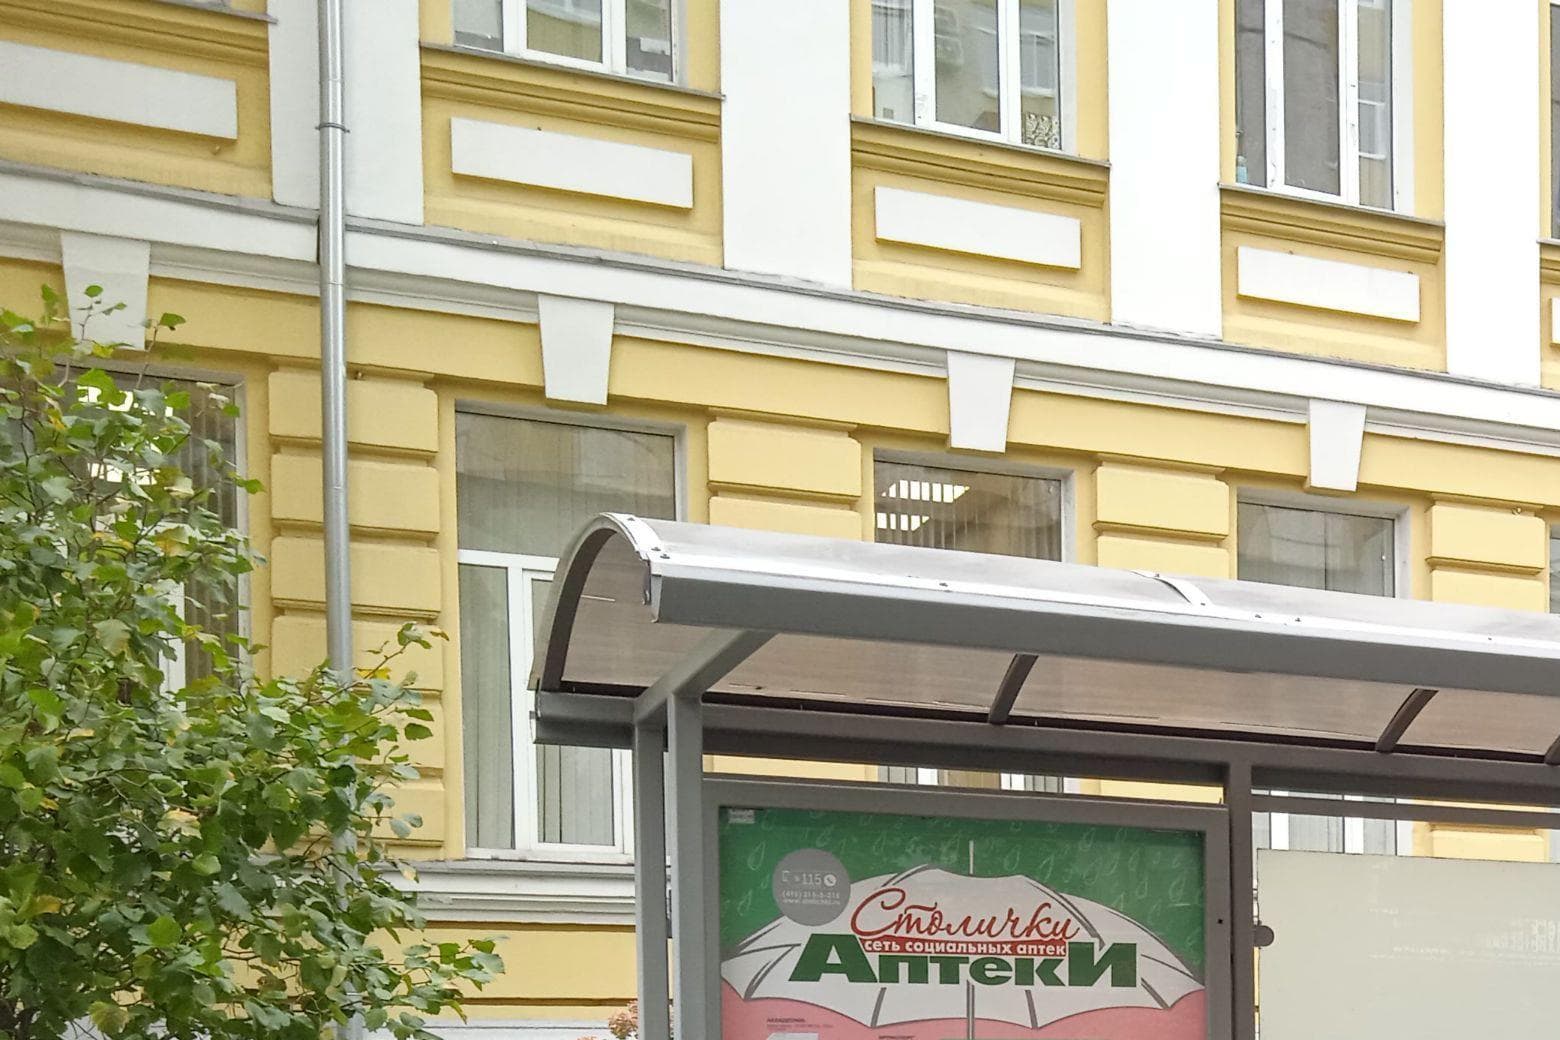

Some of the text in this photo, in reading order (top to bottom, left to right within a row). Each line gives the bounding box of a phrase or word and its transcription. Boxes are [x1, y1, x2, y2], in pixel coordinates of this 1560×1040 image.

[851, 888, 1080, 940] Столички
[864, 940, 1065, 955] сеть социальных аптек
